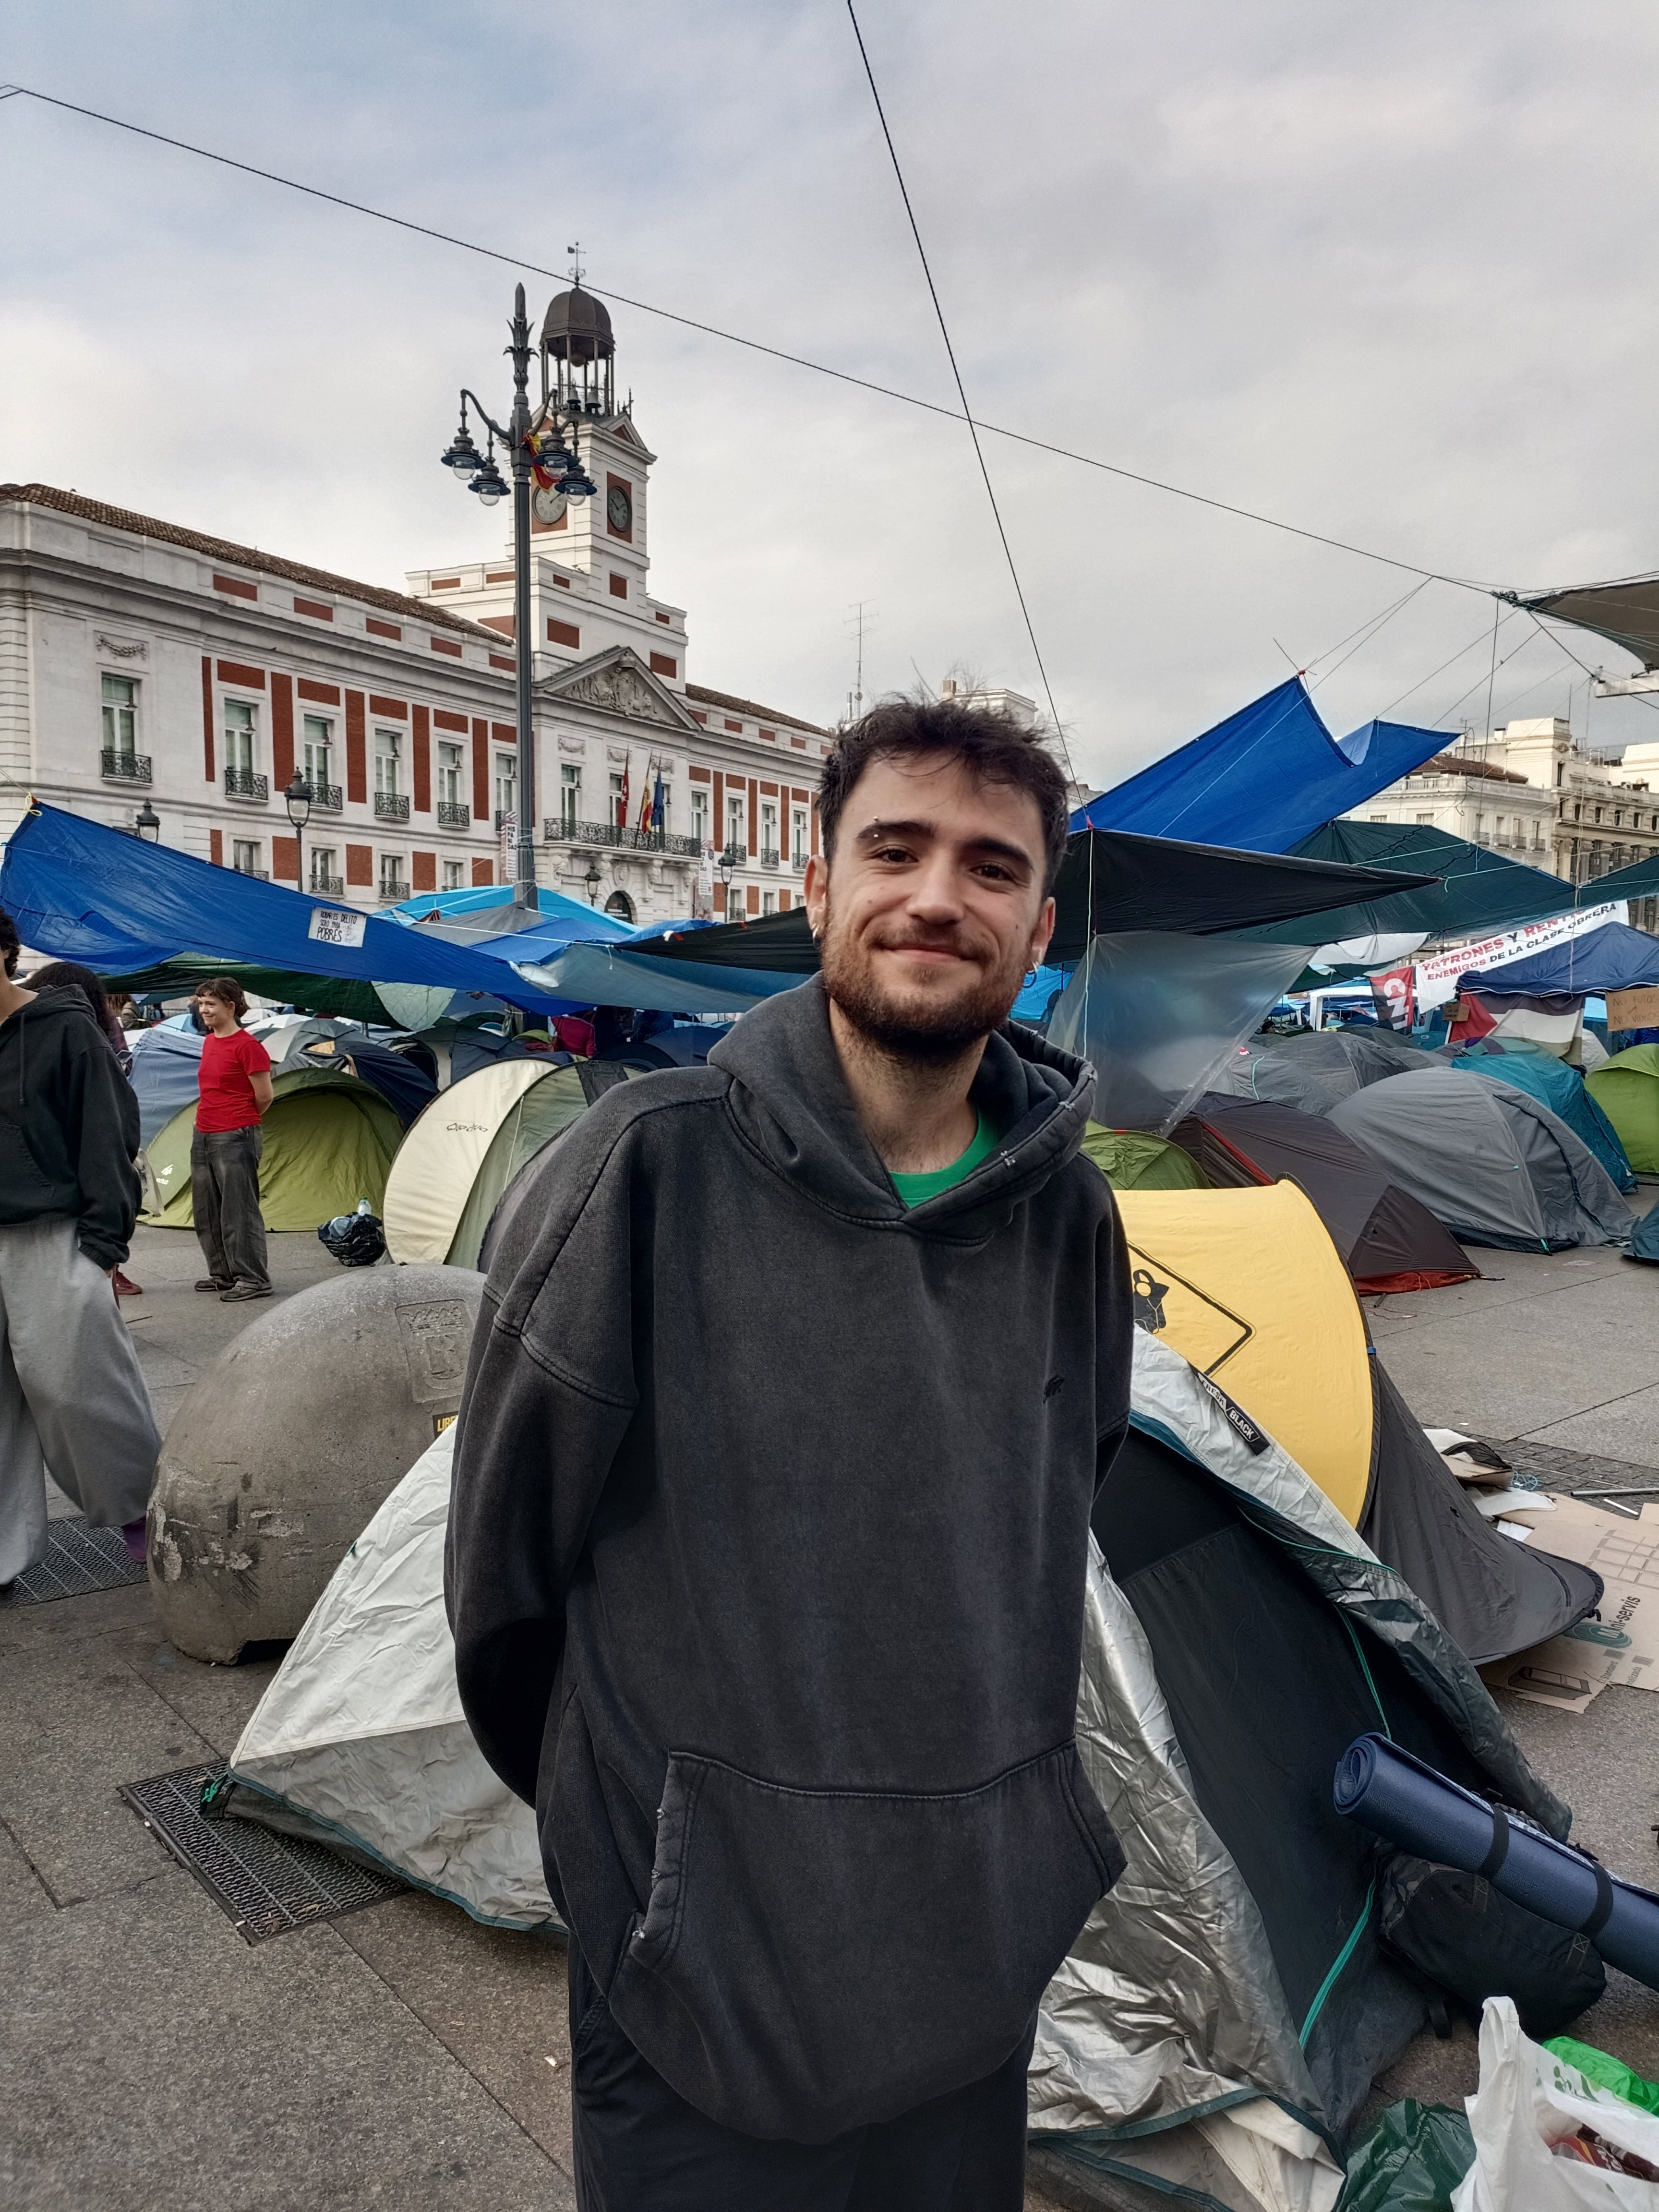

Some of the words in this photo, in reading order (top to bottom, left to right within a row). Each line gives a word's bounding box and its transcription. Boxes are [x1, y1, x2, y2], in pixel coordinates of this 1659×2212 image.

[341, 913, 357, 925] DELITO
[317, 926, 342, 942] POBRES
[1428, 960, 1486, 980] ENEMIGOS
[1490, 952, 1505, 962] DE
[1509, 946, 1523, 955] LA
[1527, 927, 1564, 949] CLASE
[1568, 903, 1617, 929] OBRERA
[1422, 938, 1504, 971] PATRONES
[1507, 932, 1517, 943] Y
[1383, 978, 1409, 1030] CNT
[1613, 997, 1627, 1006] NO
[1633, 994, 1659, 1004] FOTOS
[1614, 1015, 1628, 1025] NO
[1229, 1409, 1254, 1439] BLACK
[1597, 1596, 1641, 1638] Mini-servis
[1600, 1661, 1619, 1680] Standard
